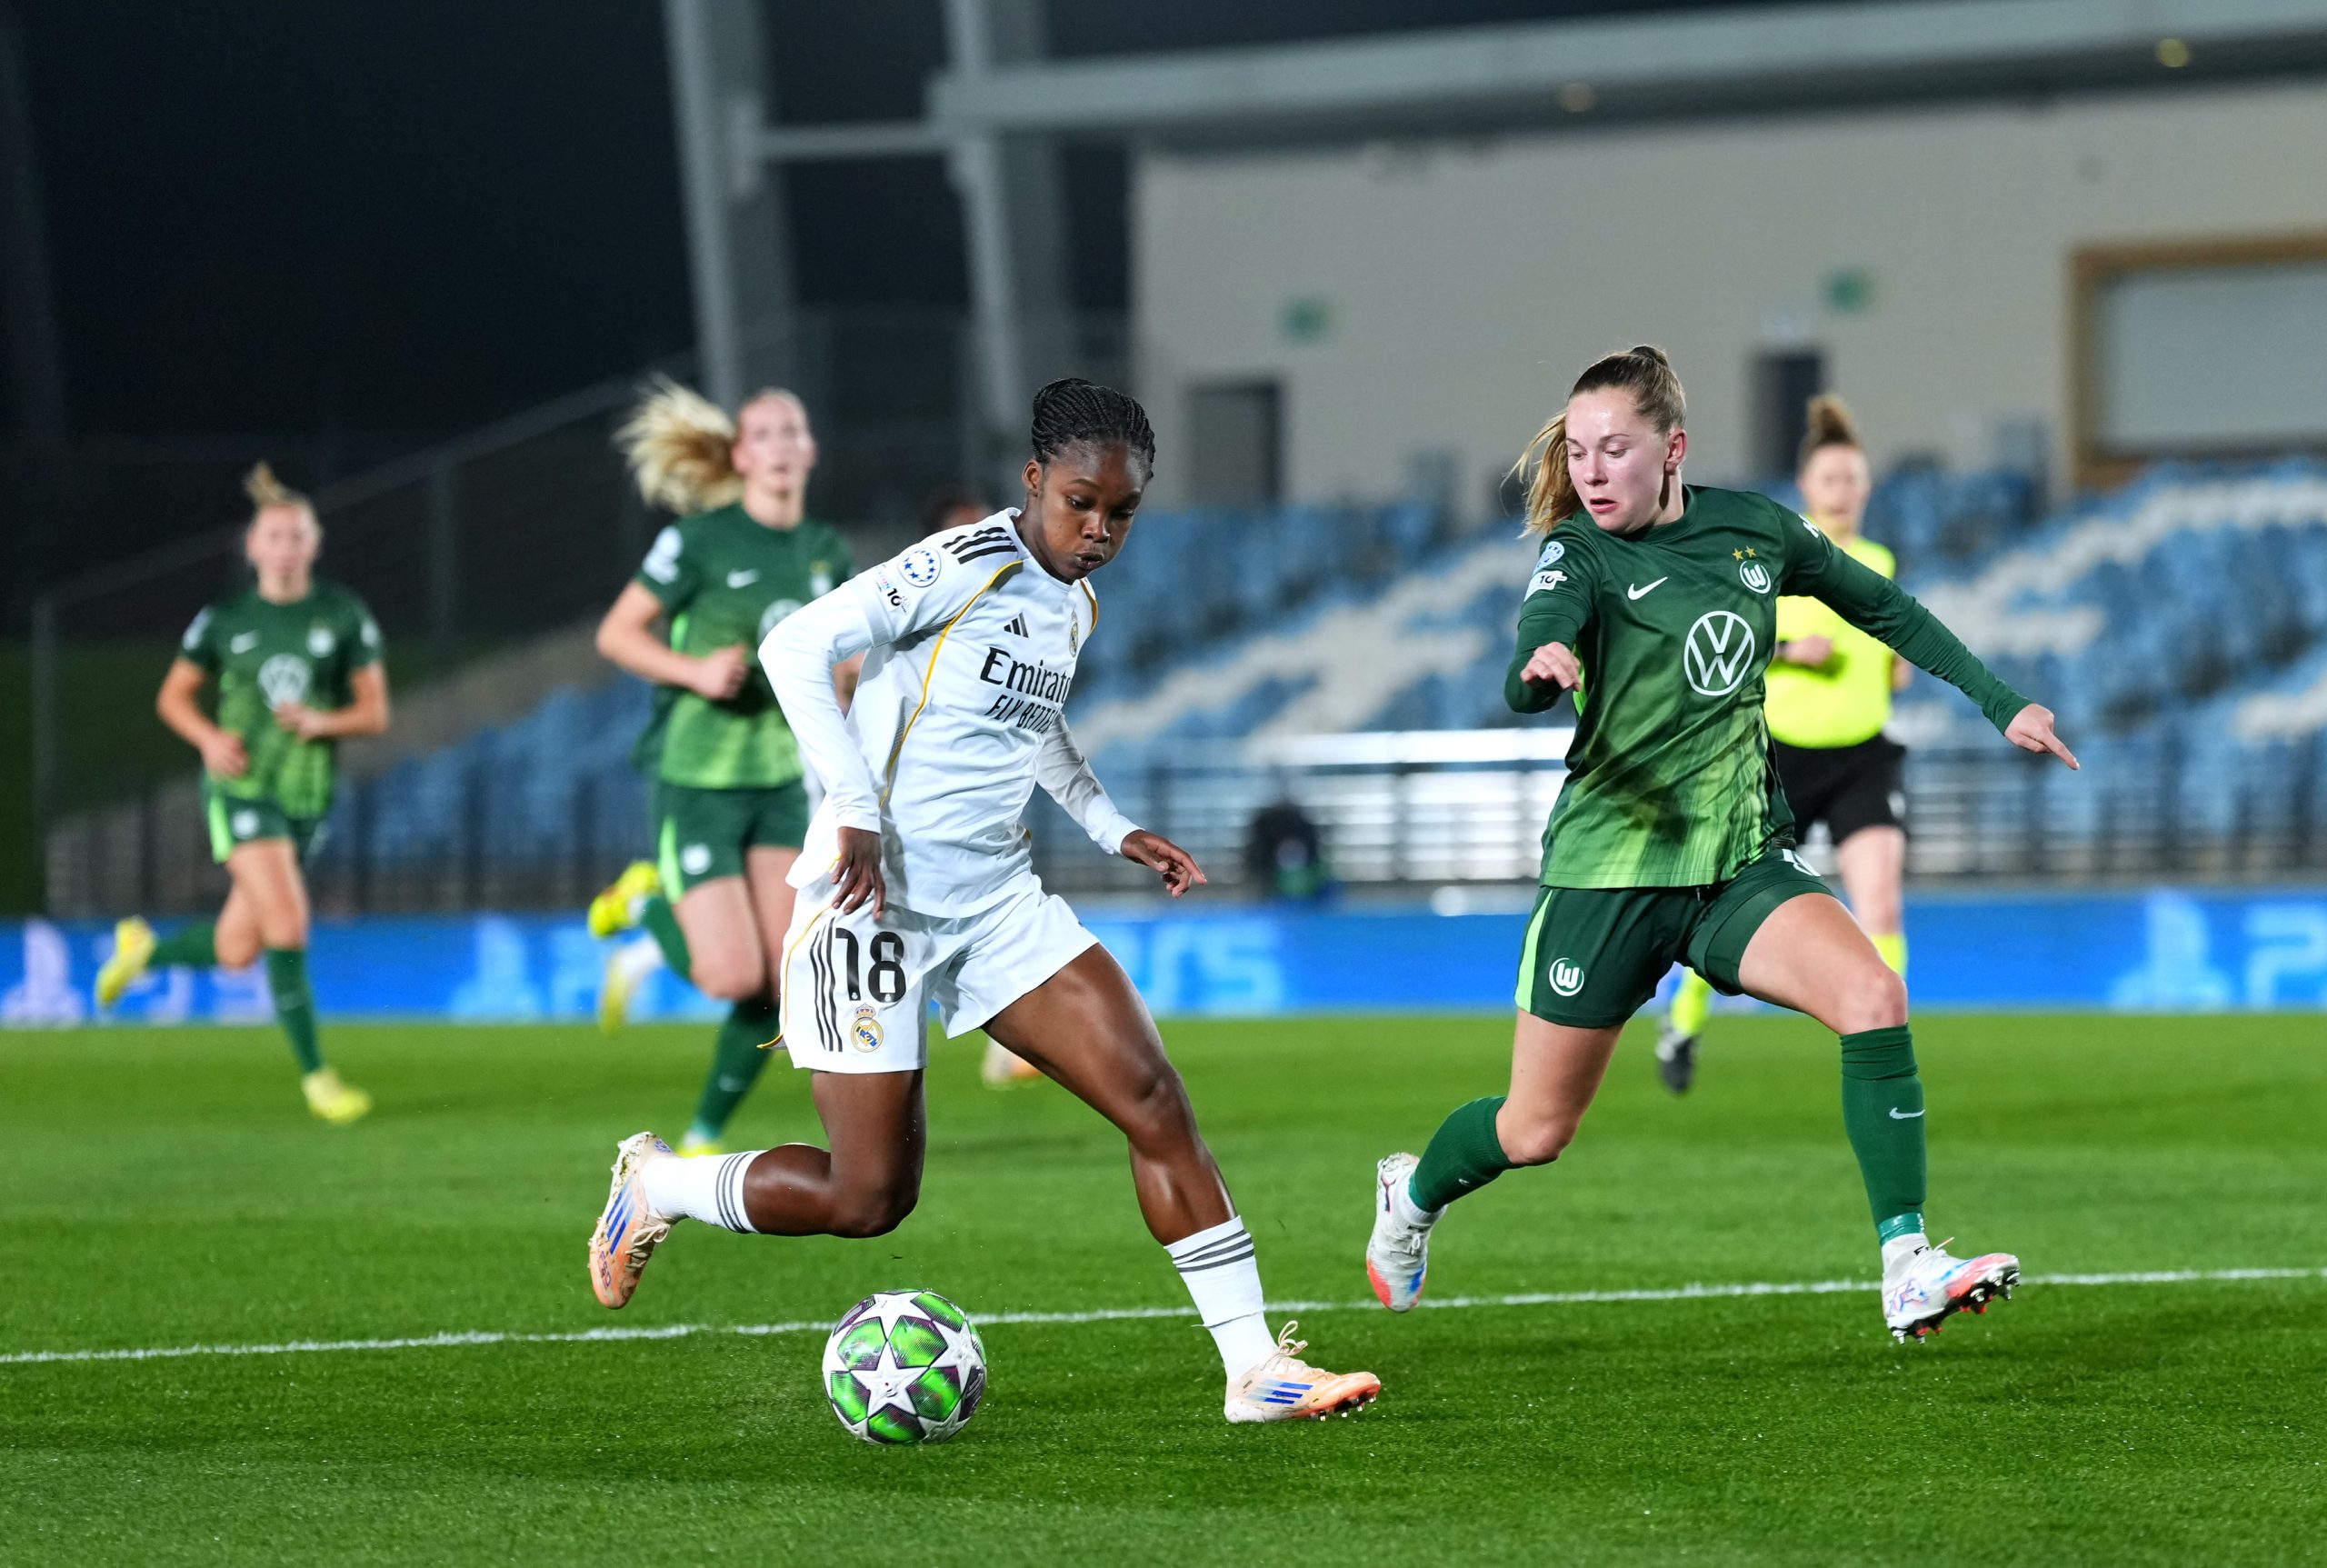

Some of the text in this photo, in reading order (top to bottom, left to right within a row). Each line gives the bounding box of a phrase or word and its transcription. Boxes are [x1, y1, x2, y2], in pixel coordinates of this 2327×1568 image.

[1684, 611, 1754, 695] VW
[984, 694, 1024, 724] FLY
[835, 927, 906, 1003] 18
